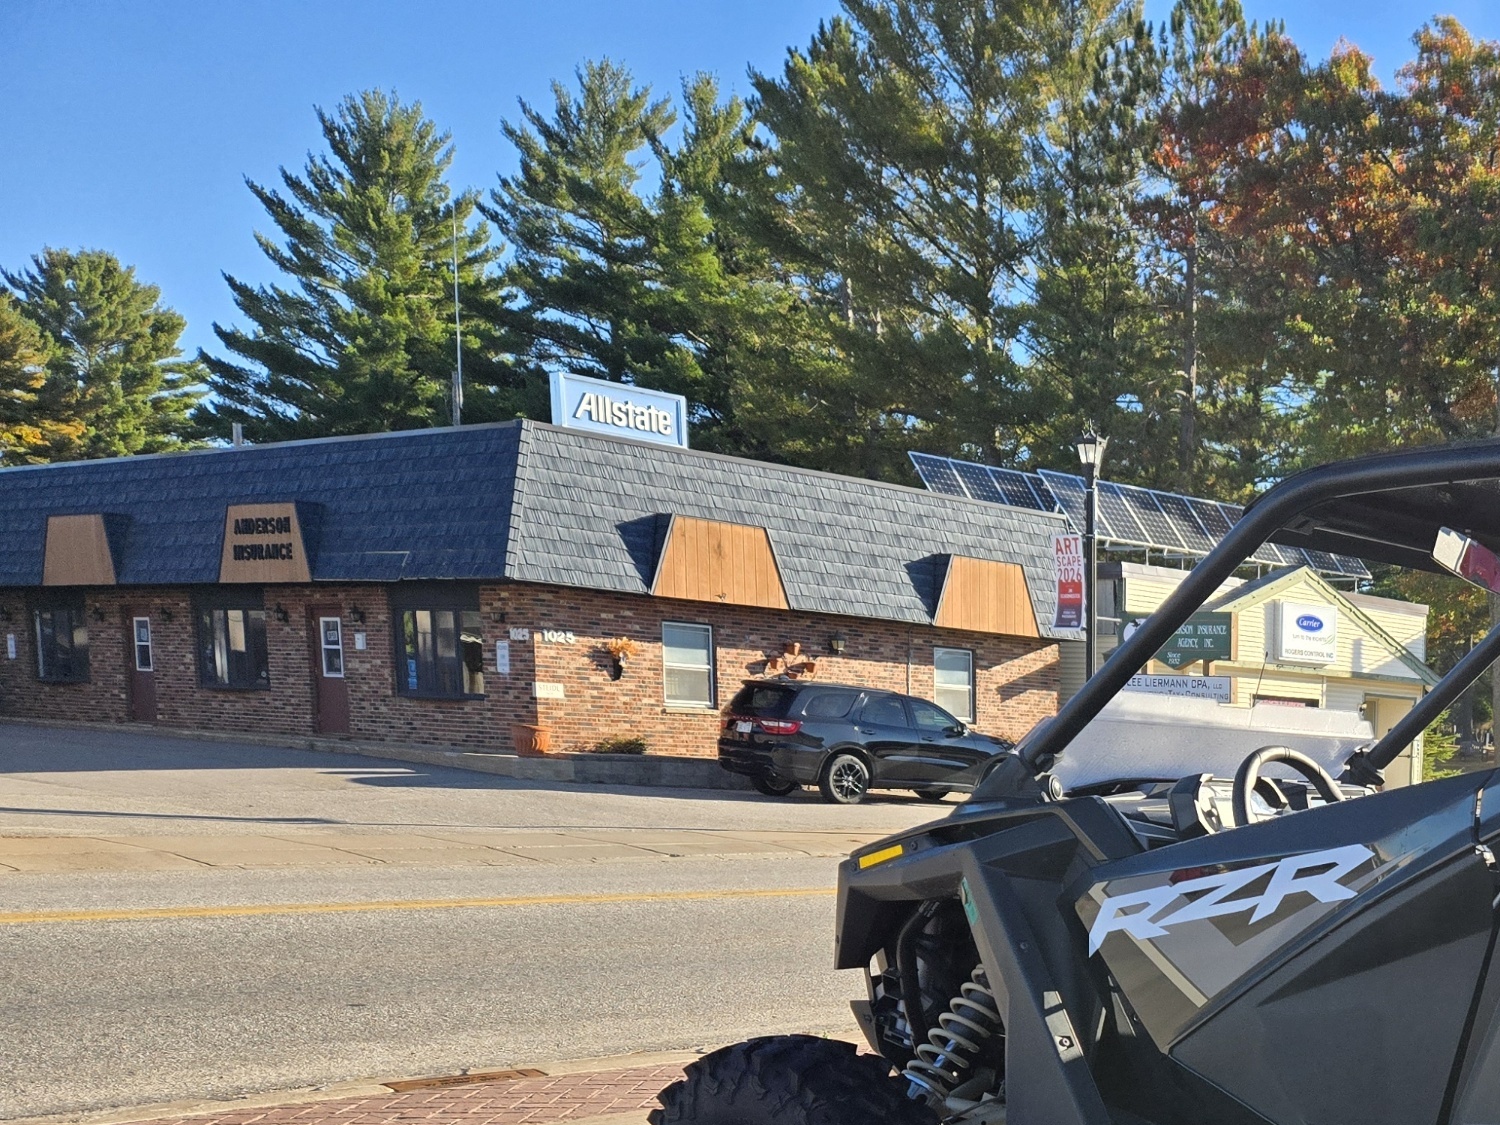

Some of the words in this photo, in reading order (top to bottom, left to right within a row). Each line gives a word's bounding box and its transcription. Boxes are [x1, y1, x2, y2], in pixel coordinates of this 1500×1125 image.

[573, 392, 673, 436] Allstate
[234, 516, 291, 535] ANDERSON
[233, 543, 293, 561] INSURANCE
[1055, 537, 1080, 555] ART
[1057, 556, 1082, 567] SCAPE
[1197, 624, 1227, 635] INSURANCE
[1299, 618, 1320, 627] Carrier
[542, 629, 576, 644] 1025
[1285, 648, 1304, 656] ROGERS
[1304, 650, 1325, 658] CONTROL
[1145, 678, 1188, 689] LIERMANN
[1088, 843, 1376, 958] RZR
